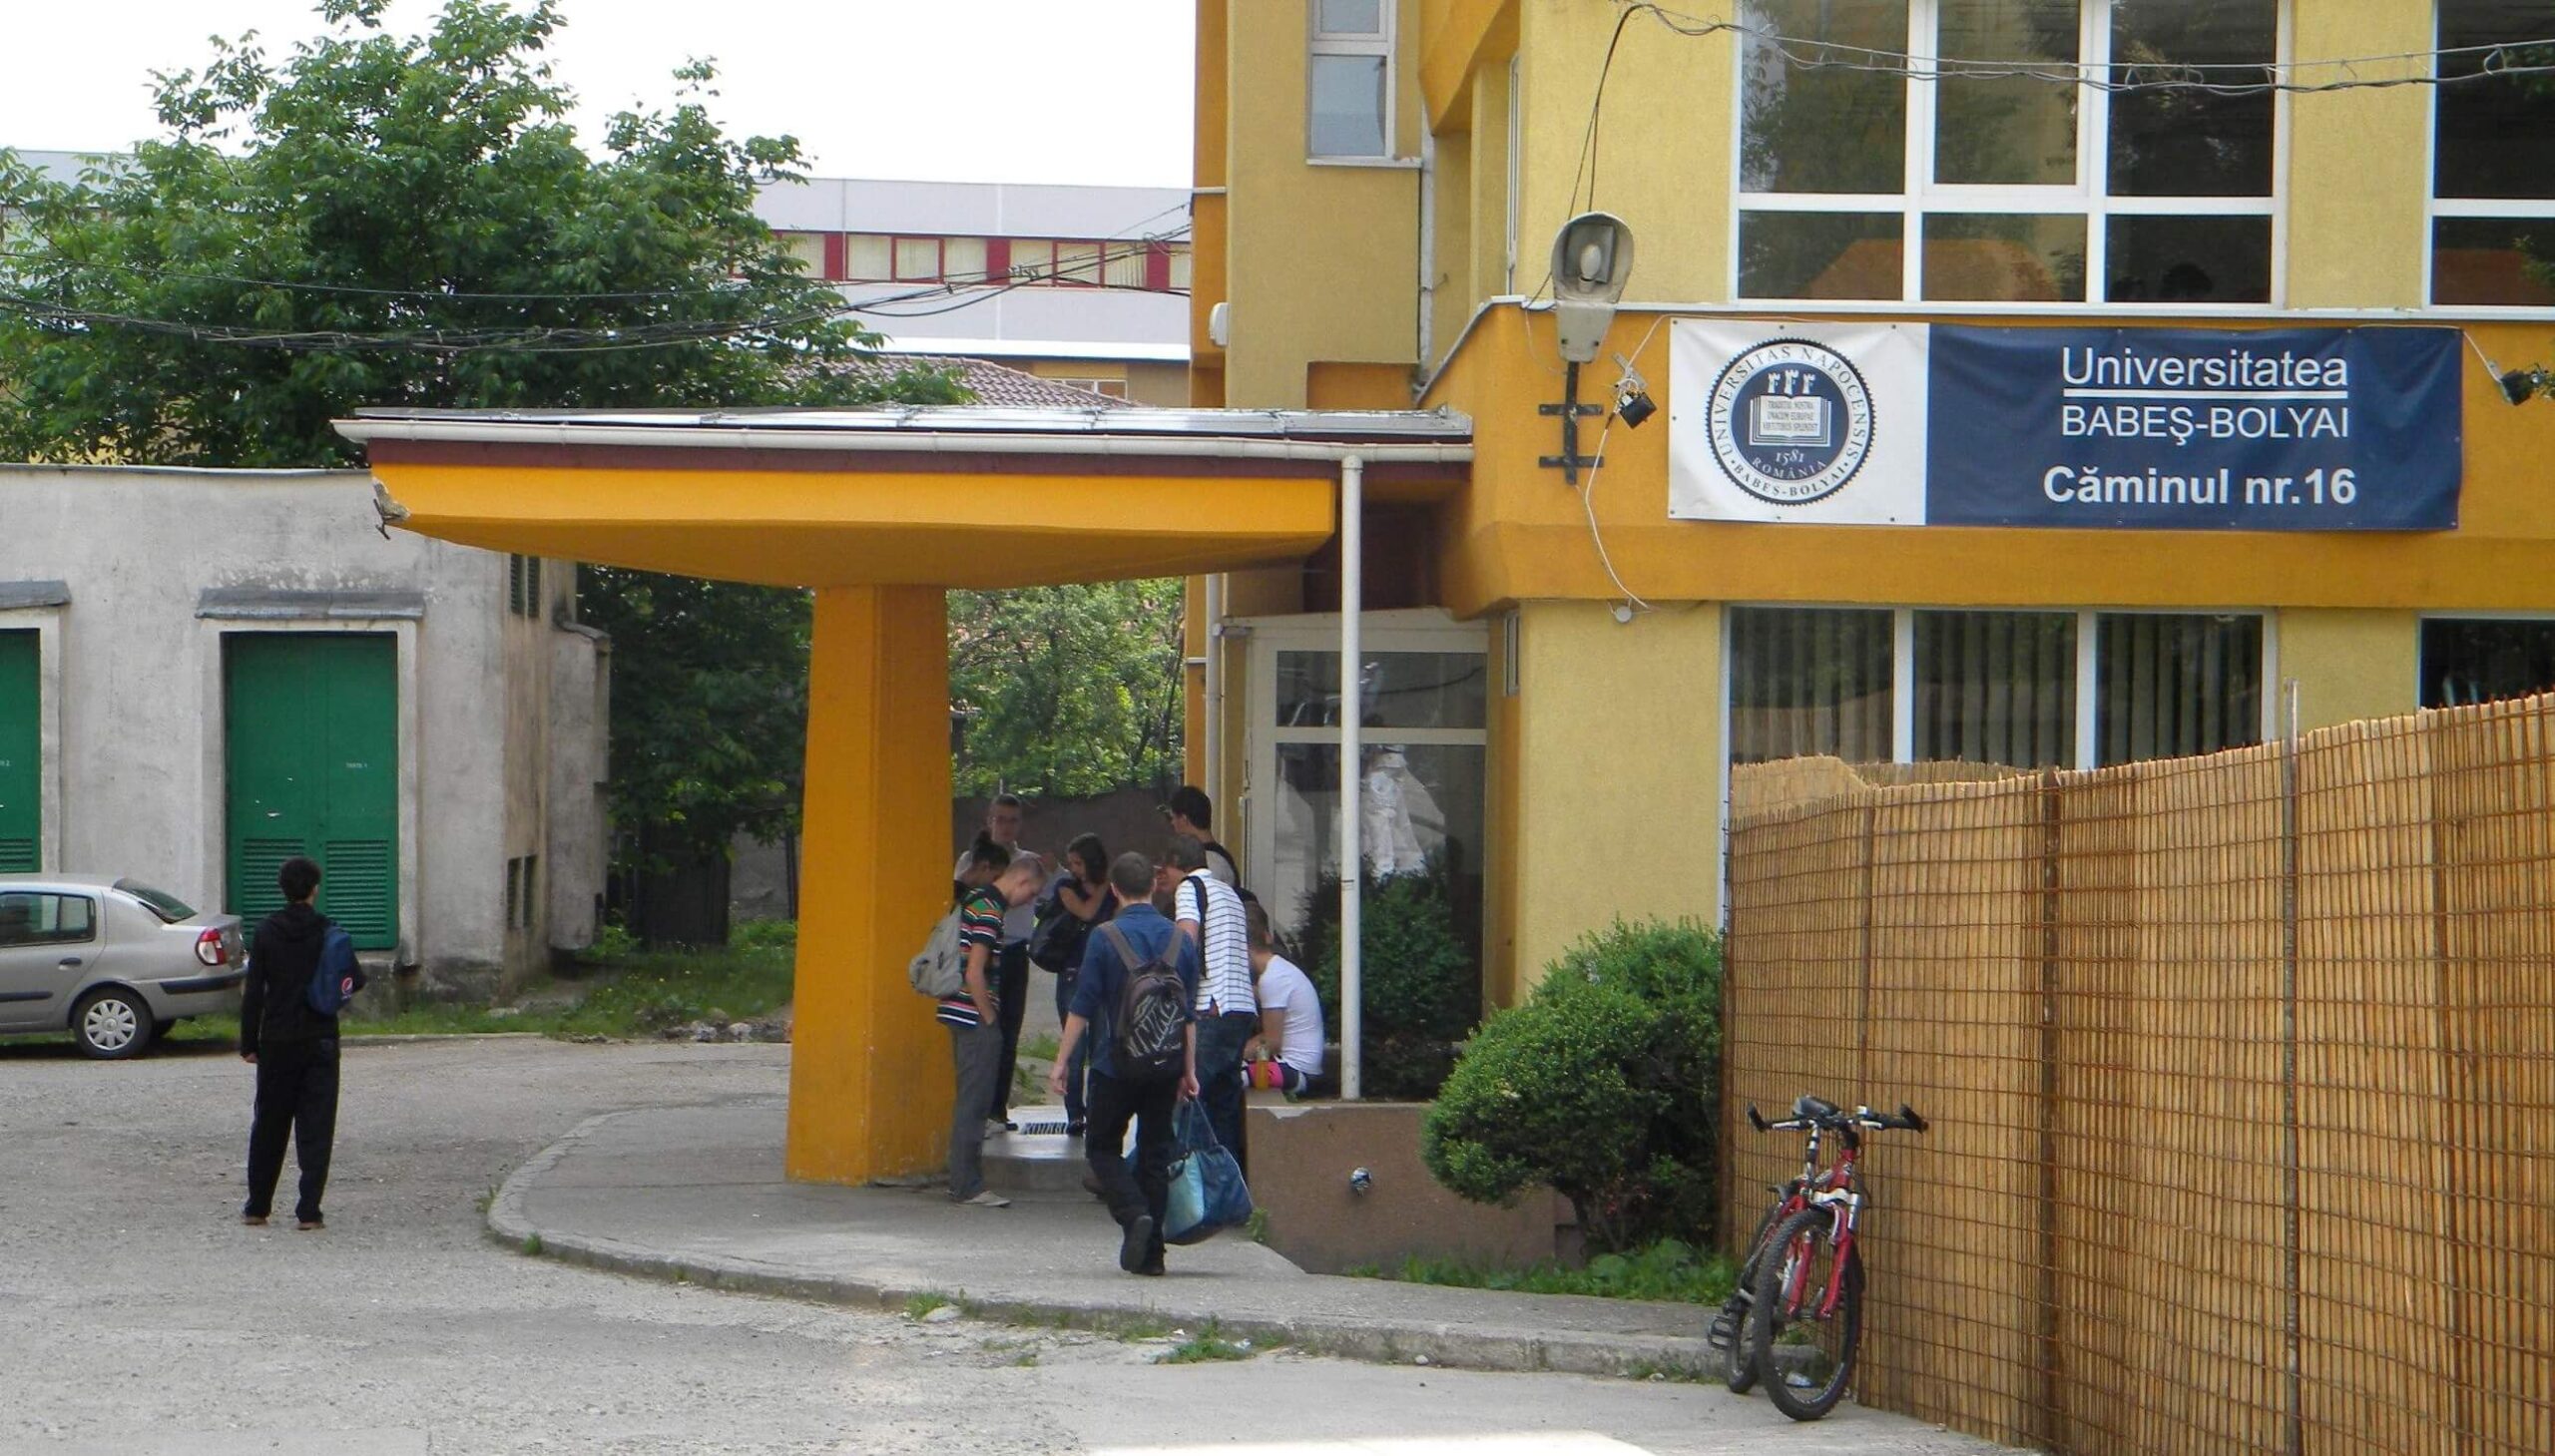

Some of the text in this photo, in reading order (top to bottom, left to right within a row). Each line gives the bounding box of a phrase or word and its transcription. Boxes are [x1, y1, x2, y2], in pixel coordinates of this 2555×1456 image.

[2062, 346, 2348, 386] Universitatea
[1714, 345, 1868, 460] UNIVERSITAS NAPOCENSIS
[2062, 405, 2348, 446] BABEŞ-BOLYAI
[1776, 449, 1805, 466] 1581
[2043, 465, 2356, 505] Căminul nr.16
